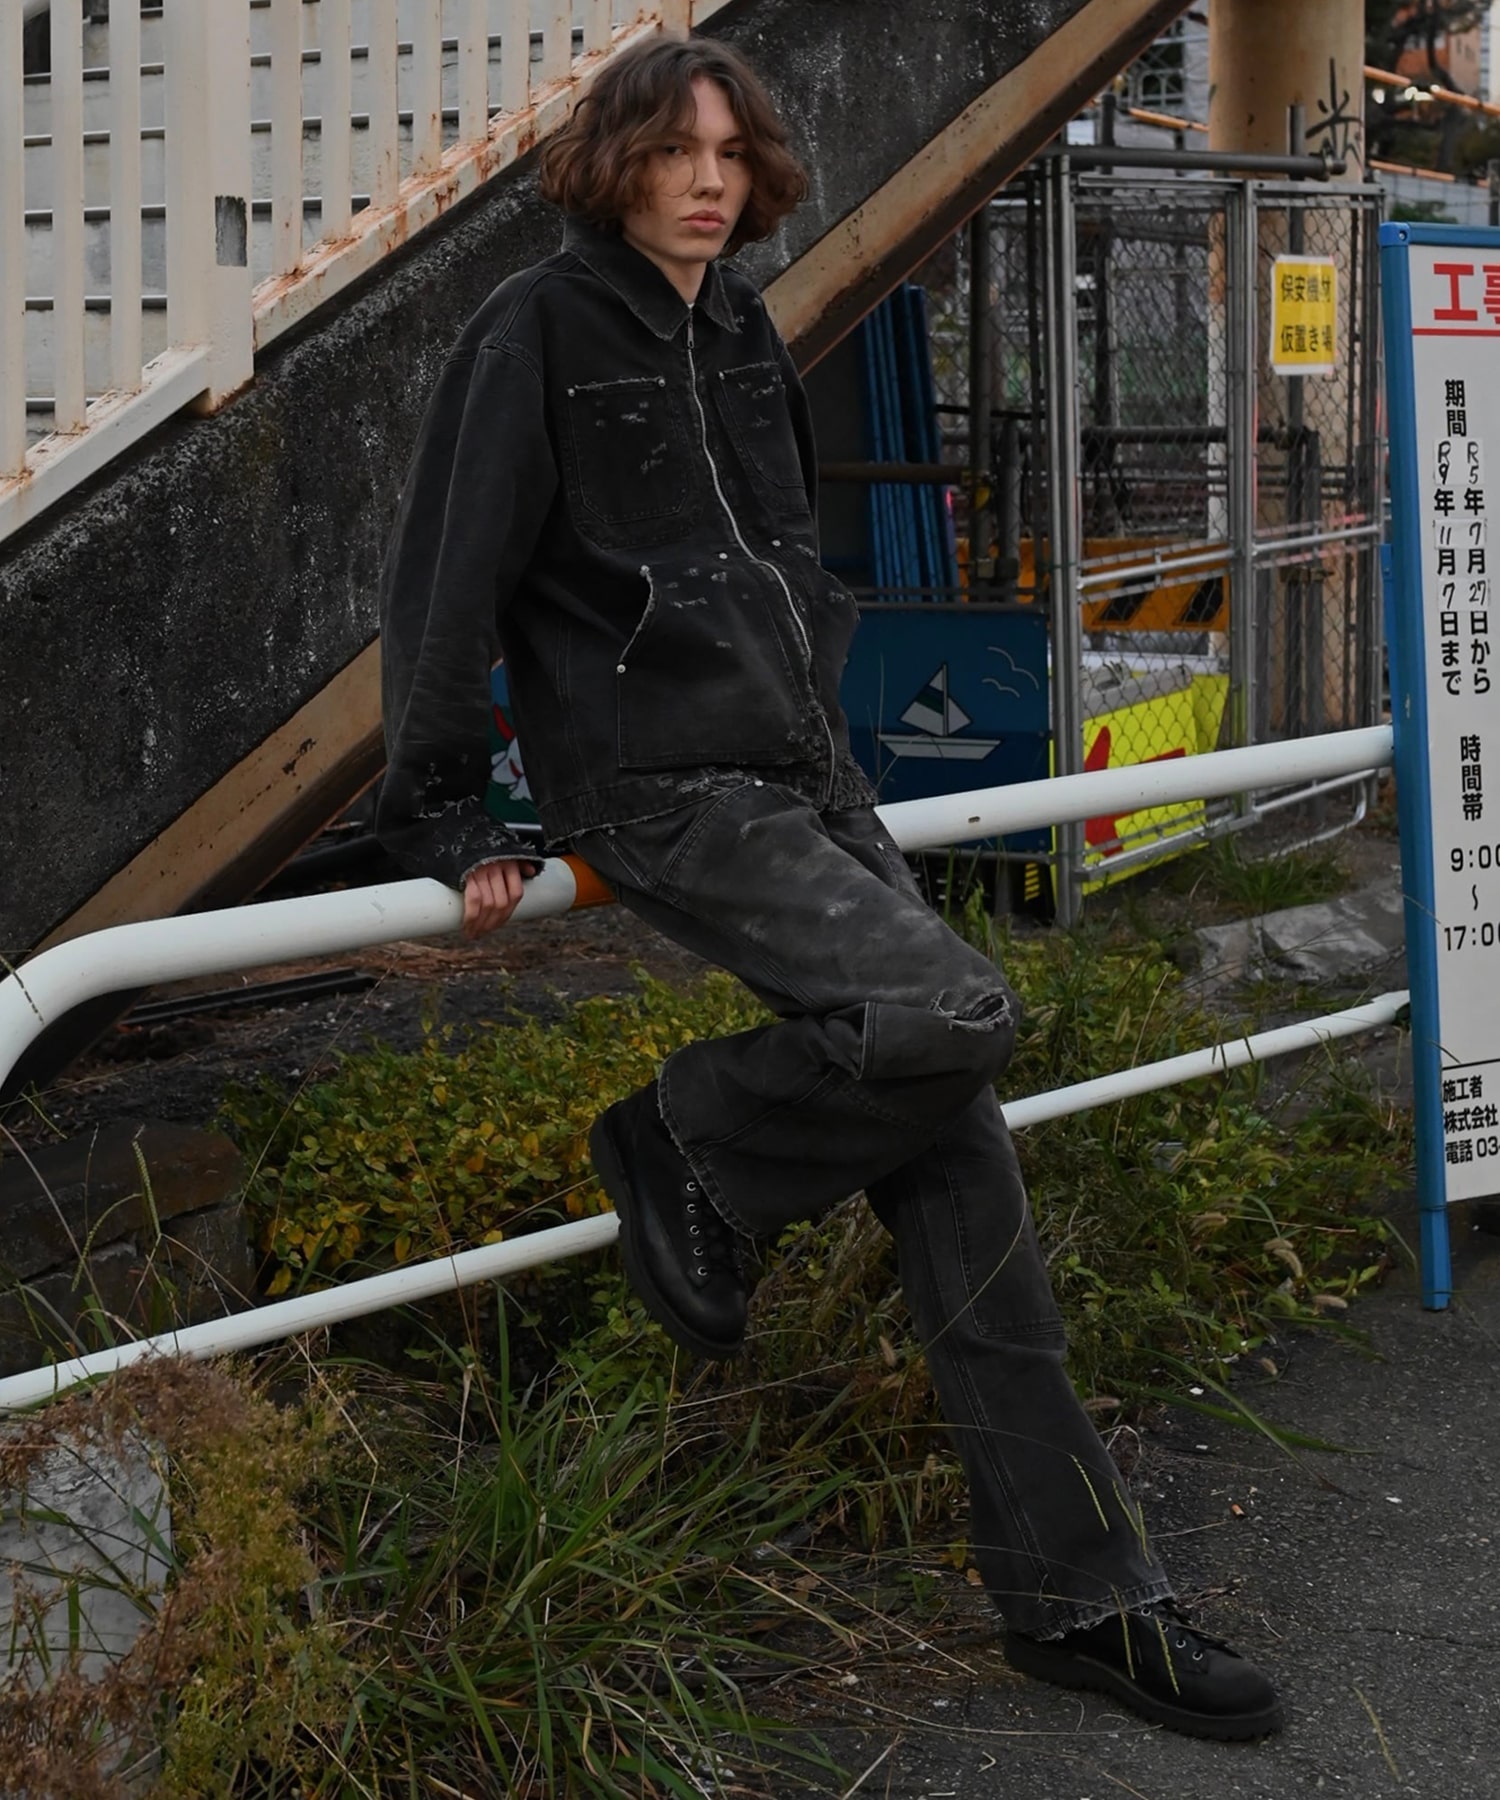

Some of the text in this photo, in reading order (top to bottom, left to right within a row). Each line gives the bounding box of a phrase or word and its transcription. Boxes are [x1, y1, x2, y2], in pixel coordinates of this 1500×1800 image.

[1444, 379, 1467, 437] 期間
[1460, 734, 1483, 821] 時間帯
[1444, 922, 1500, 951] 17:0
[1442, 1074, 1483, 1103] 施工者
[1443, 1103, 1499, 1135] 株式会社
[1476, 1135, 1500, 1158] 03
